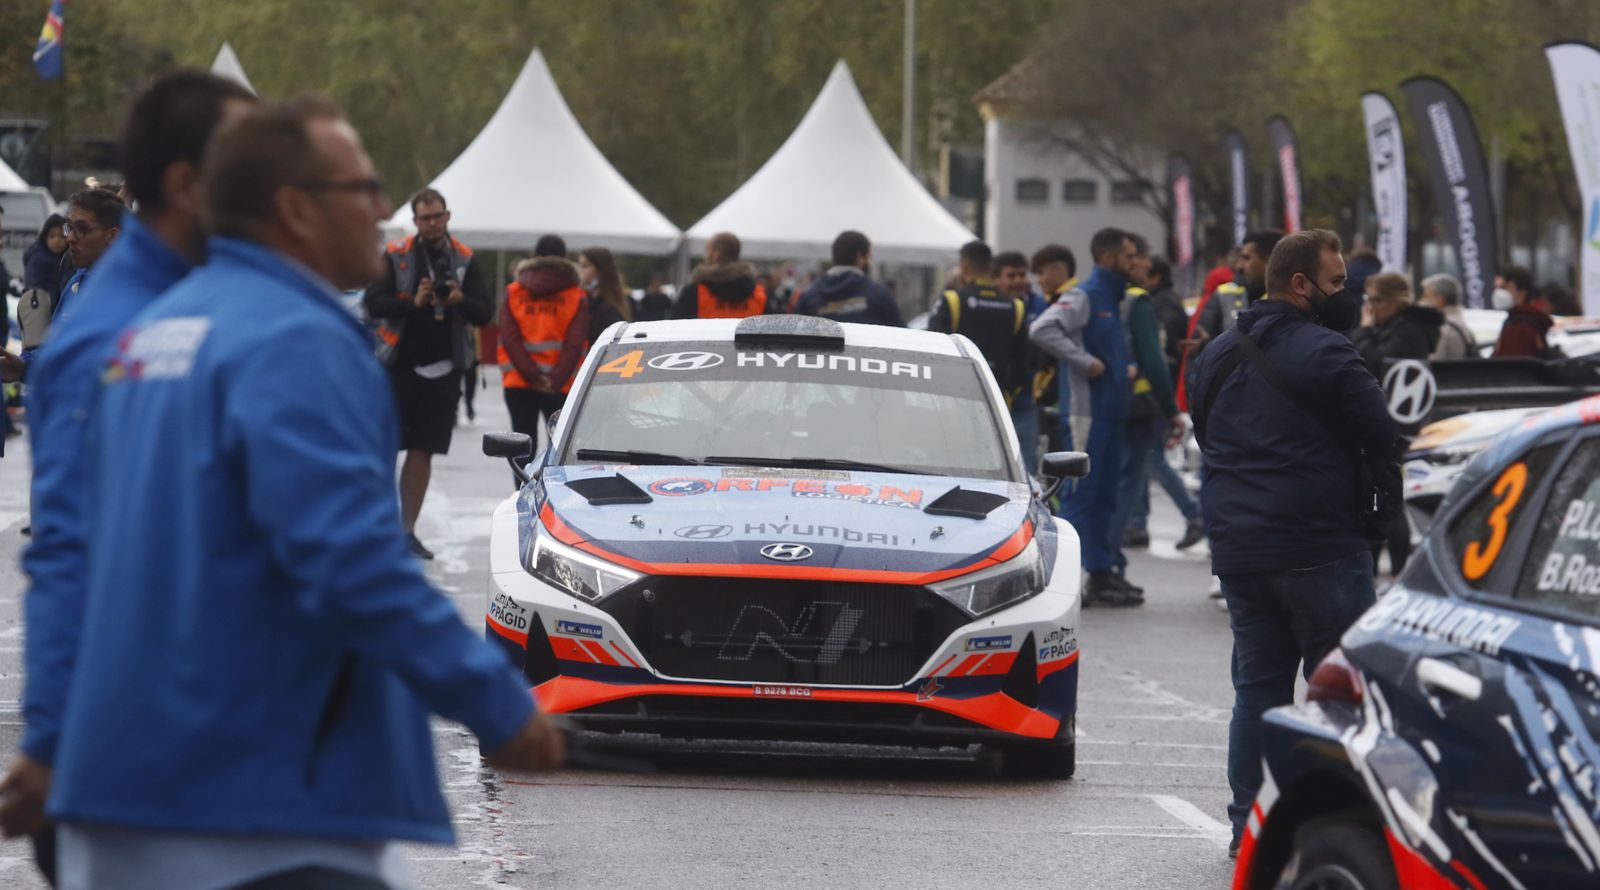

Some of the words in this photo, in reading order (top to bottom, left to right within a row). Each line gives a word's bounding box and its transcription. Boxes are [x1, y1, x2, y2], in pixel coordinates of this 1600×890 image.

[597, 351, 645, 378] 4
[737, 352, 932, 380] HYUNDAI
[1462, 461, 1528, 581] 3
[745, 523, 899, 546] HYUNDAI
[495, 605, 527, 629] PAGID
[1393, 596, 1522, 657] HYUNDAI
[567, 624, 602, 635] MIHELIN
[976, 639, 1011, 649] MIHELIN
[1051, 639, 1077, 658] PAGID
[764, 687, 787, 696] 9278
